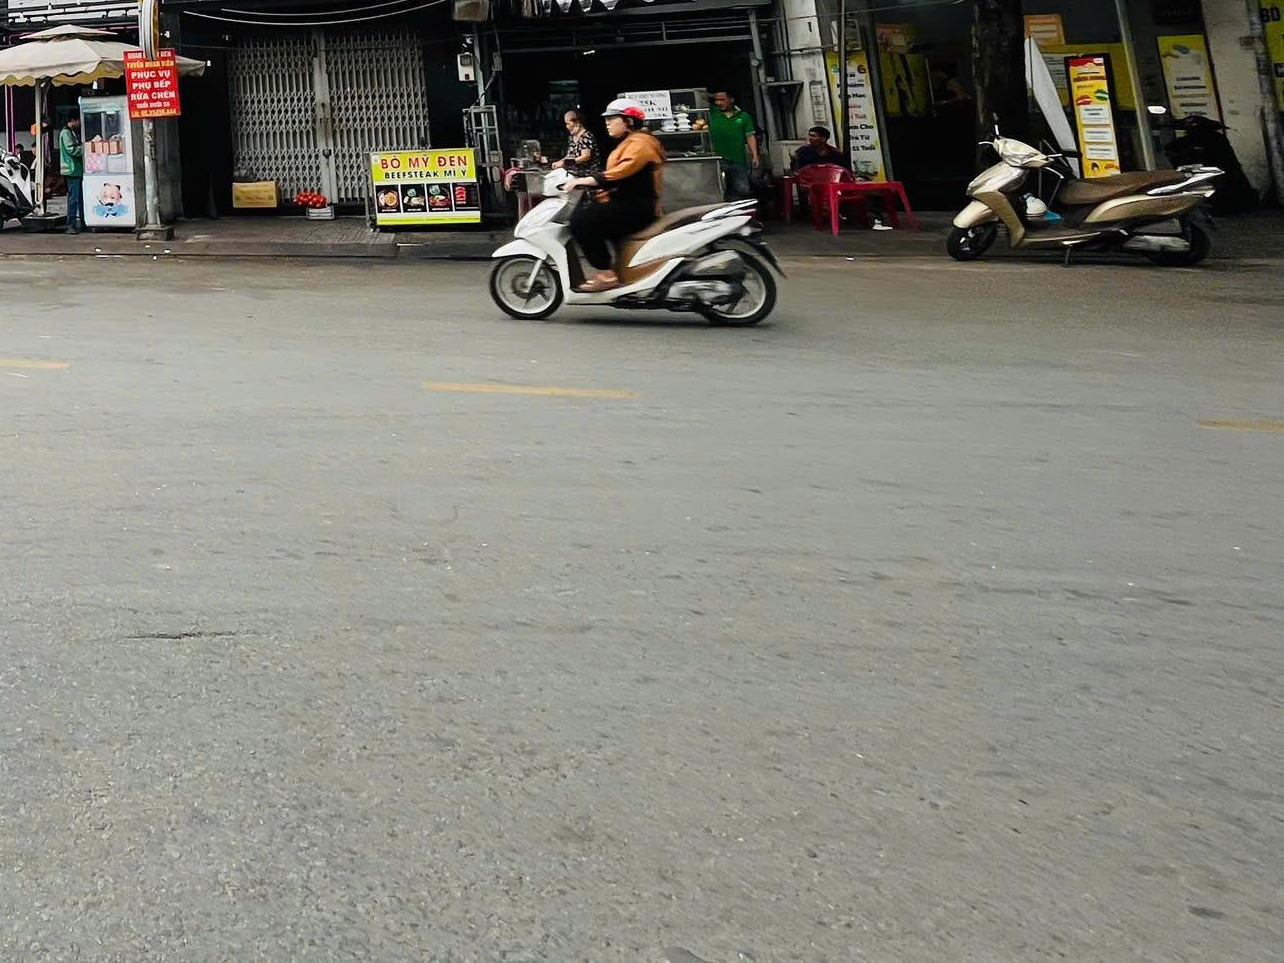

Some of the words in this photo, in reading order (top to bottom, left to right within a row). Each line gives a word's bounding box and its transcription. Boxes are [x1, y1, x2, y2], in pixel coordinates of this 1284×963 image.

[131, 70, 156, 79] PHỤC
[158, 70, 171, 78] VỤ
[132, 81, 151, 90] PHỤ
[153, 79, 171, 88] BẾP
[130, 91, 149, 101] RỬA
[381, 155, 400, 169] BÒ
[409, 154, 429, 168] MỸ
[438, 156, 467, 167] ĐEN
[385, 170, 438, 179] BEEFSTEAK
